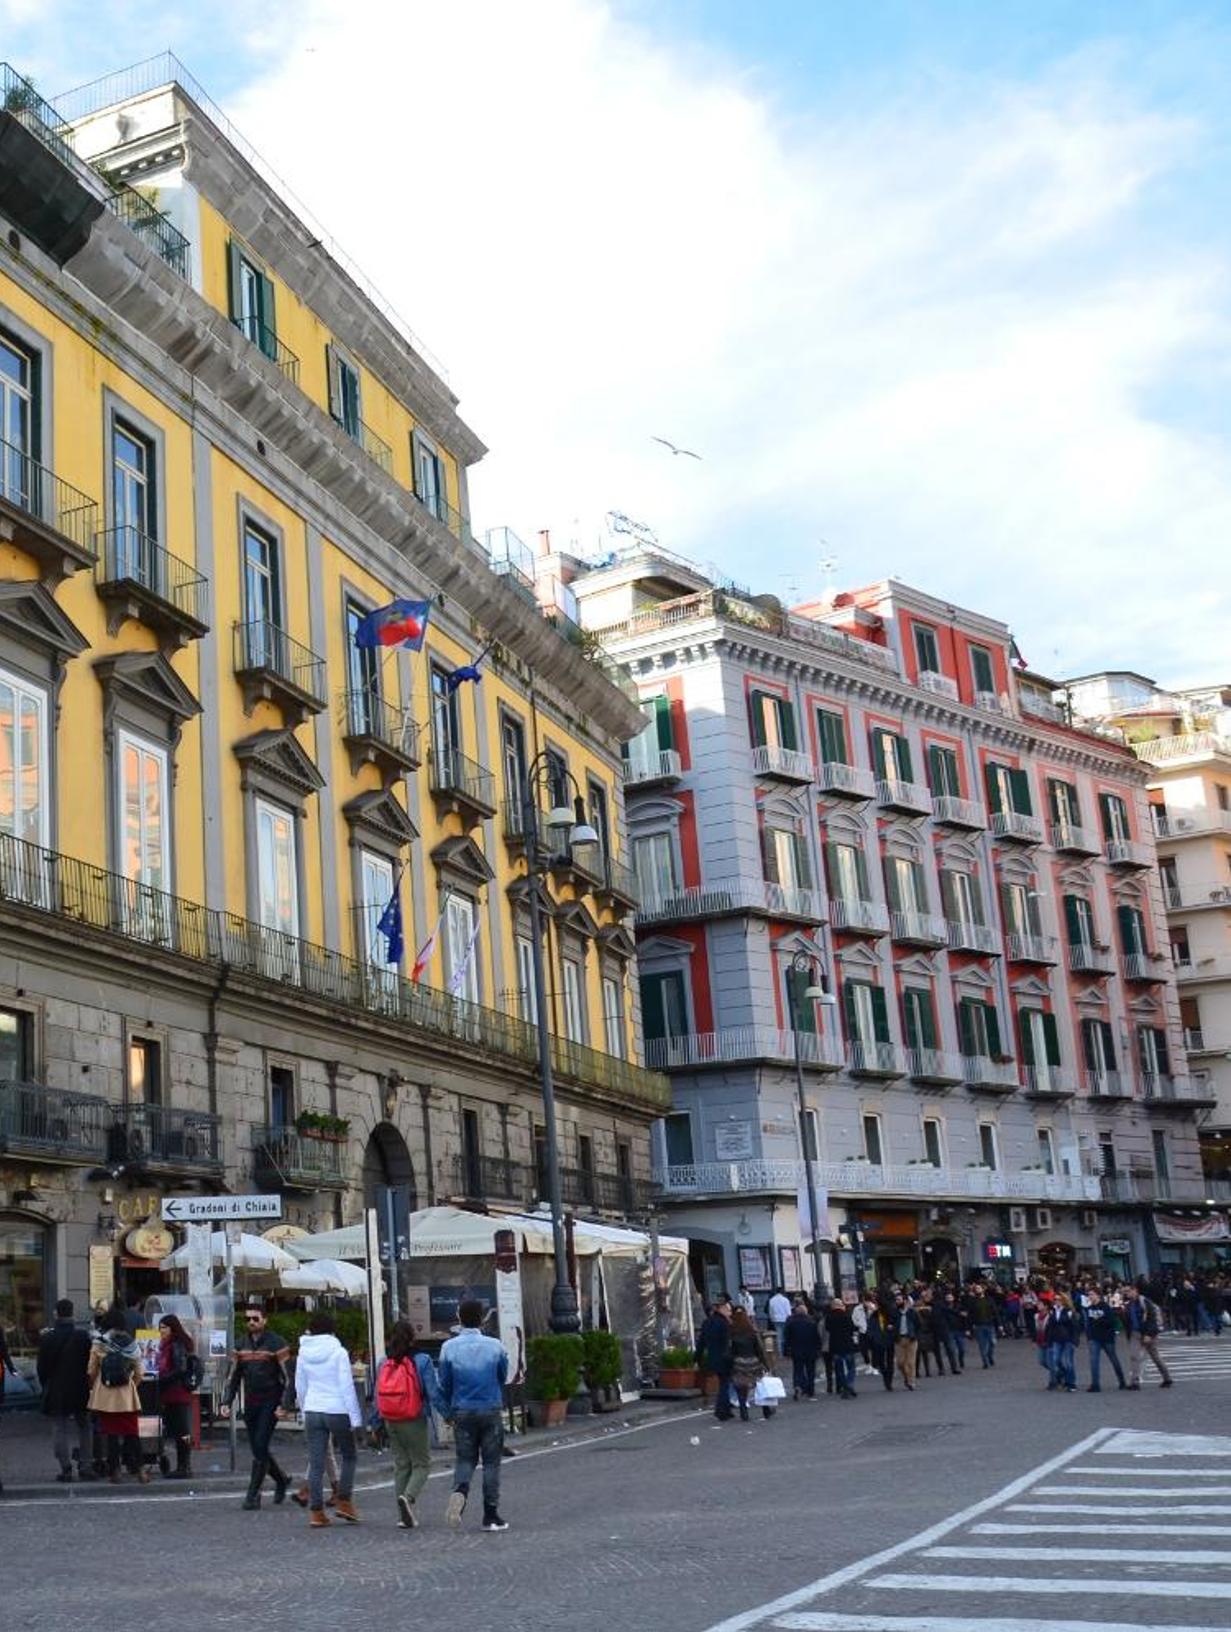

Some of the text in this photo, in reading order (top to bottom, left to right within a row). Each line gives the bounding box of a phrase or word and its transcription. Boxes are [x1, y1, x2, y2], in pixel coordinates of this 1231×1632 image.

[188, 1200, 277, 1214] Gradoni di Chiaia
